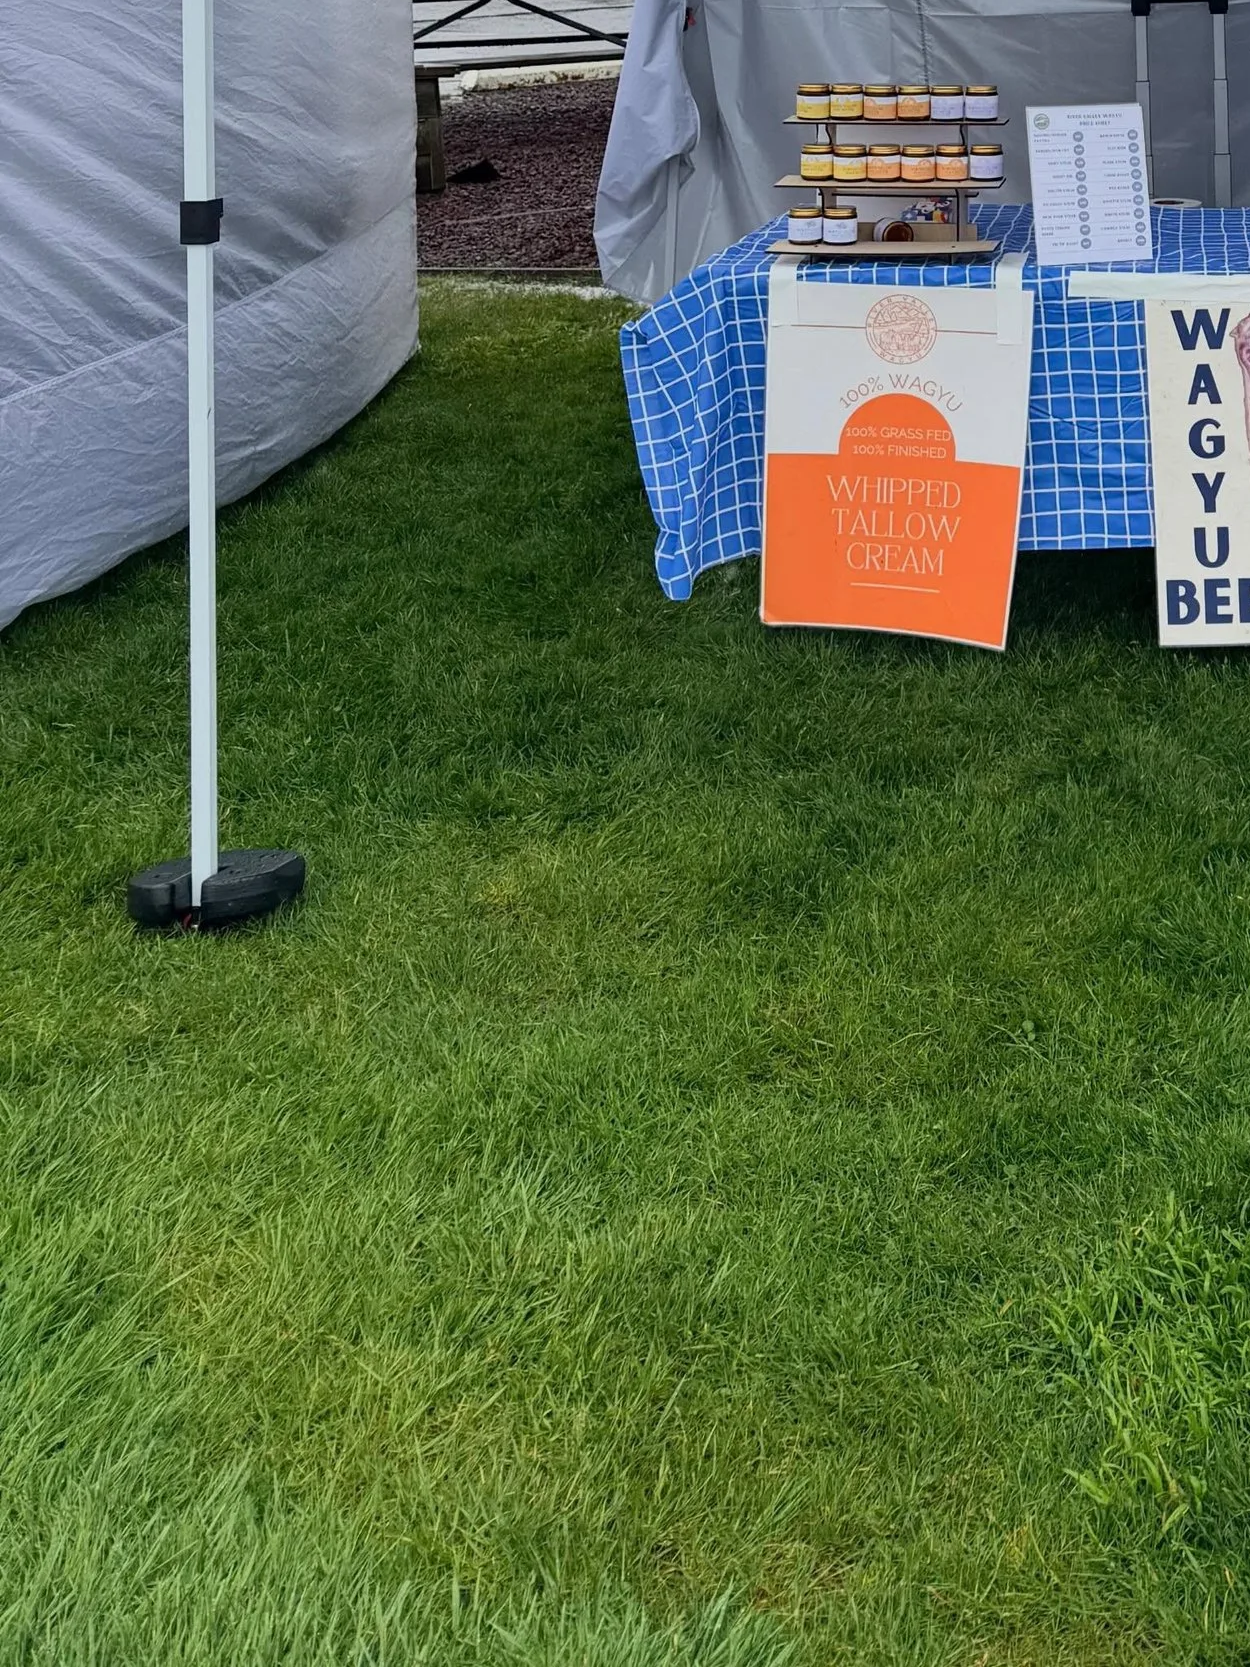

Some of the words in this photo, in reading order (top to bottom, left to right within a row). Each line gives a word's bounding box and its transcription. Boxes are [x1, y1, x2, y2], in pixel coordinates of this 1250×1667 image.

[840, 375, 884, 409] 100%
[888, 373, 963, 412] WAGYU
[846, 426, 877, 438] 100%
[880, 426, 924, 441] GRASS
[926, 429, 951, 442] FED
[1170, 308, 1231, 569] WAGYU
[852, 444, 885, 456] 100%
[887, 444, 947, 459] FINISHED
[826, 475, 962, 509] WHIPPED
[831, 508, 962, 542] TALLOW
[846, 541, 944, 576] CREAM
